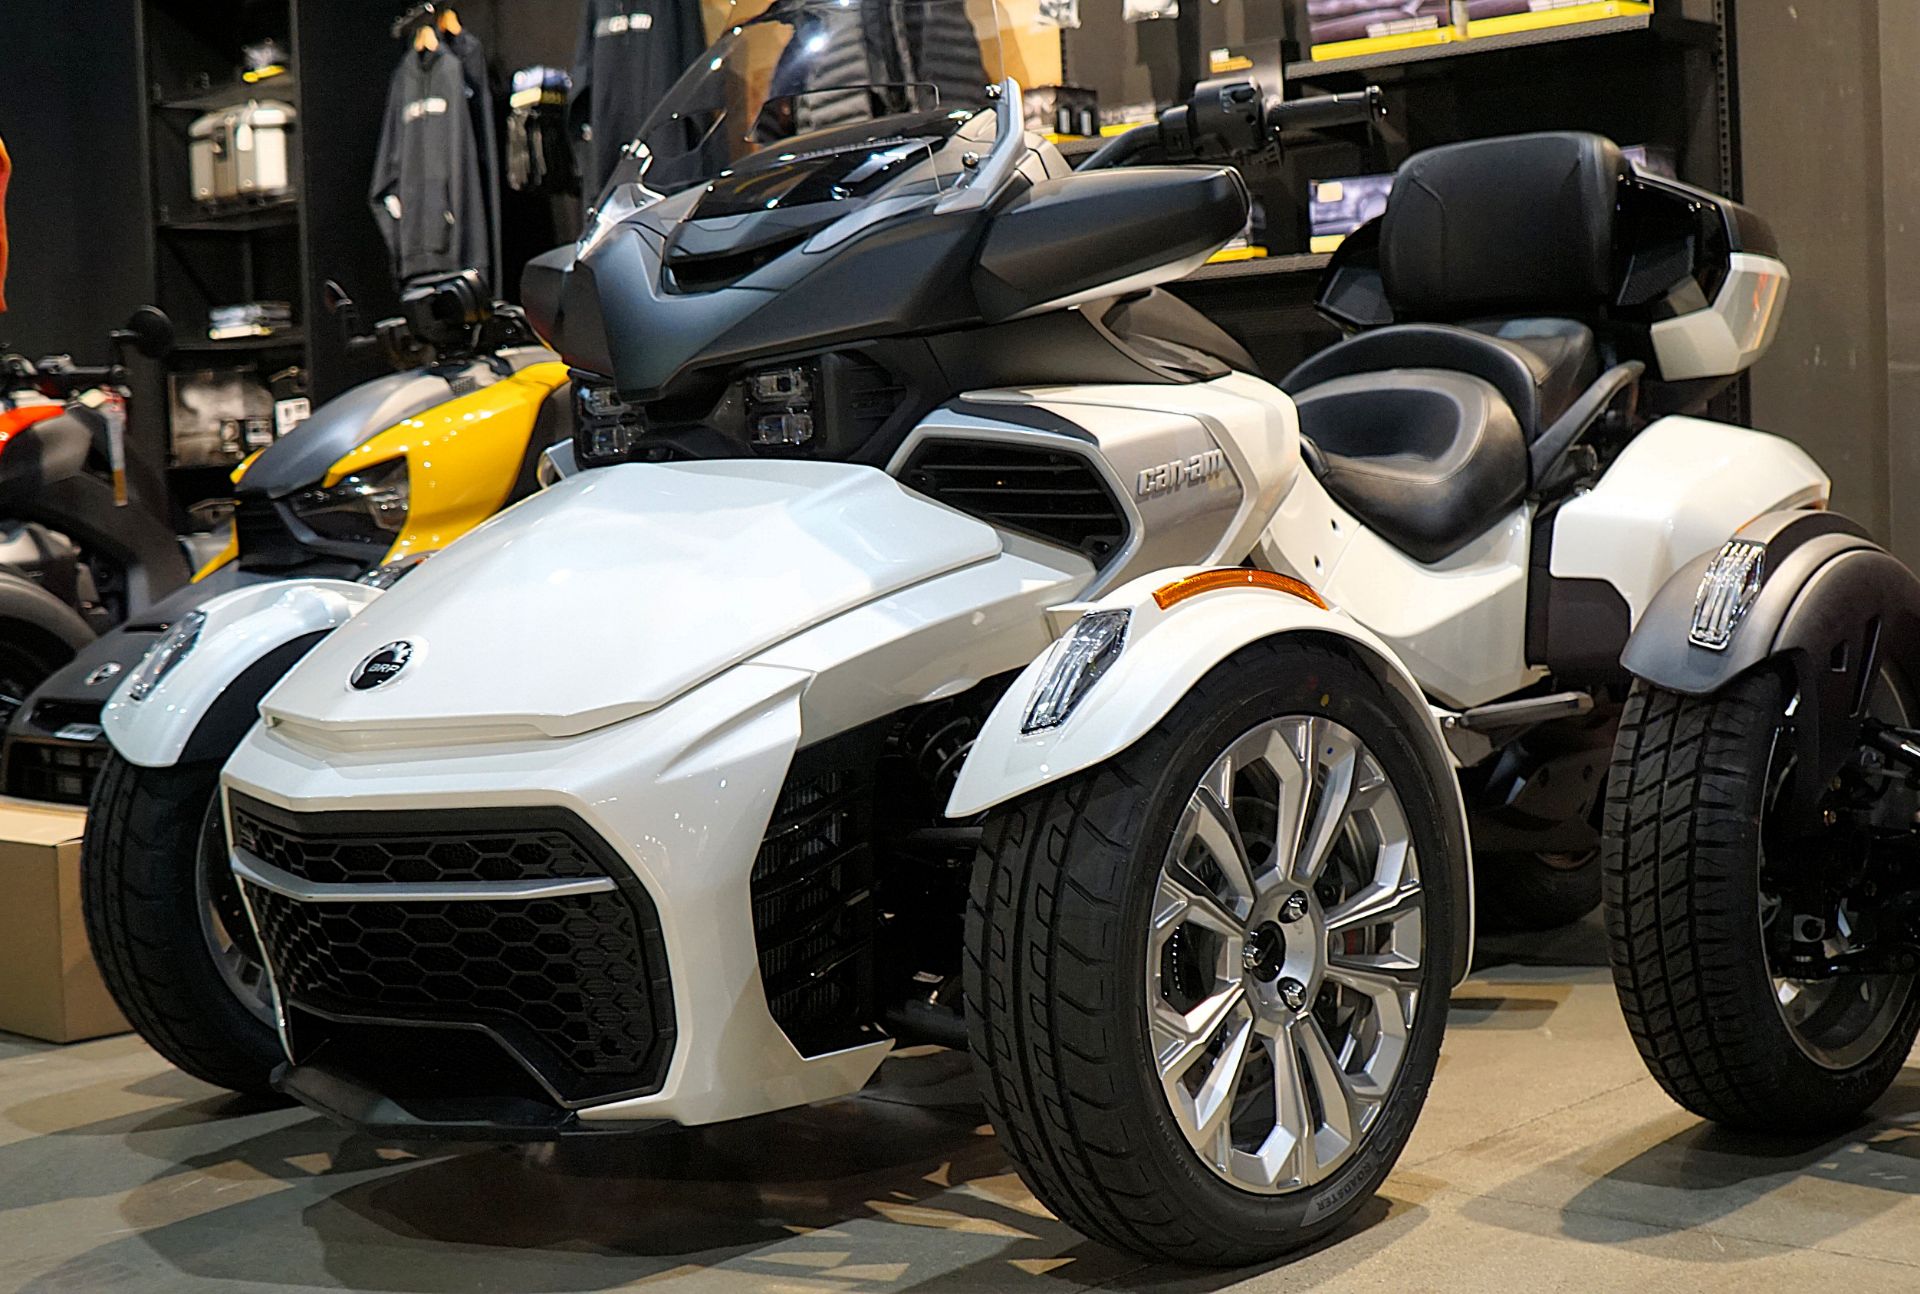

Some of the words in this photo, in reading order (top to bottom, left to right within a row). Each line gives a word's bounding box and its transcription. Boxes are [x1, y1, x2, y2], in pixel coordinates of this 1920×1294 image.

[1138, 448, 1224, 495] can-am
[367, 663, 401, 672] BRP
[1316, 1161, 1372, 1212] ROADSTER
